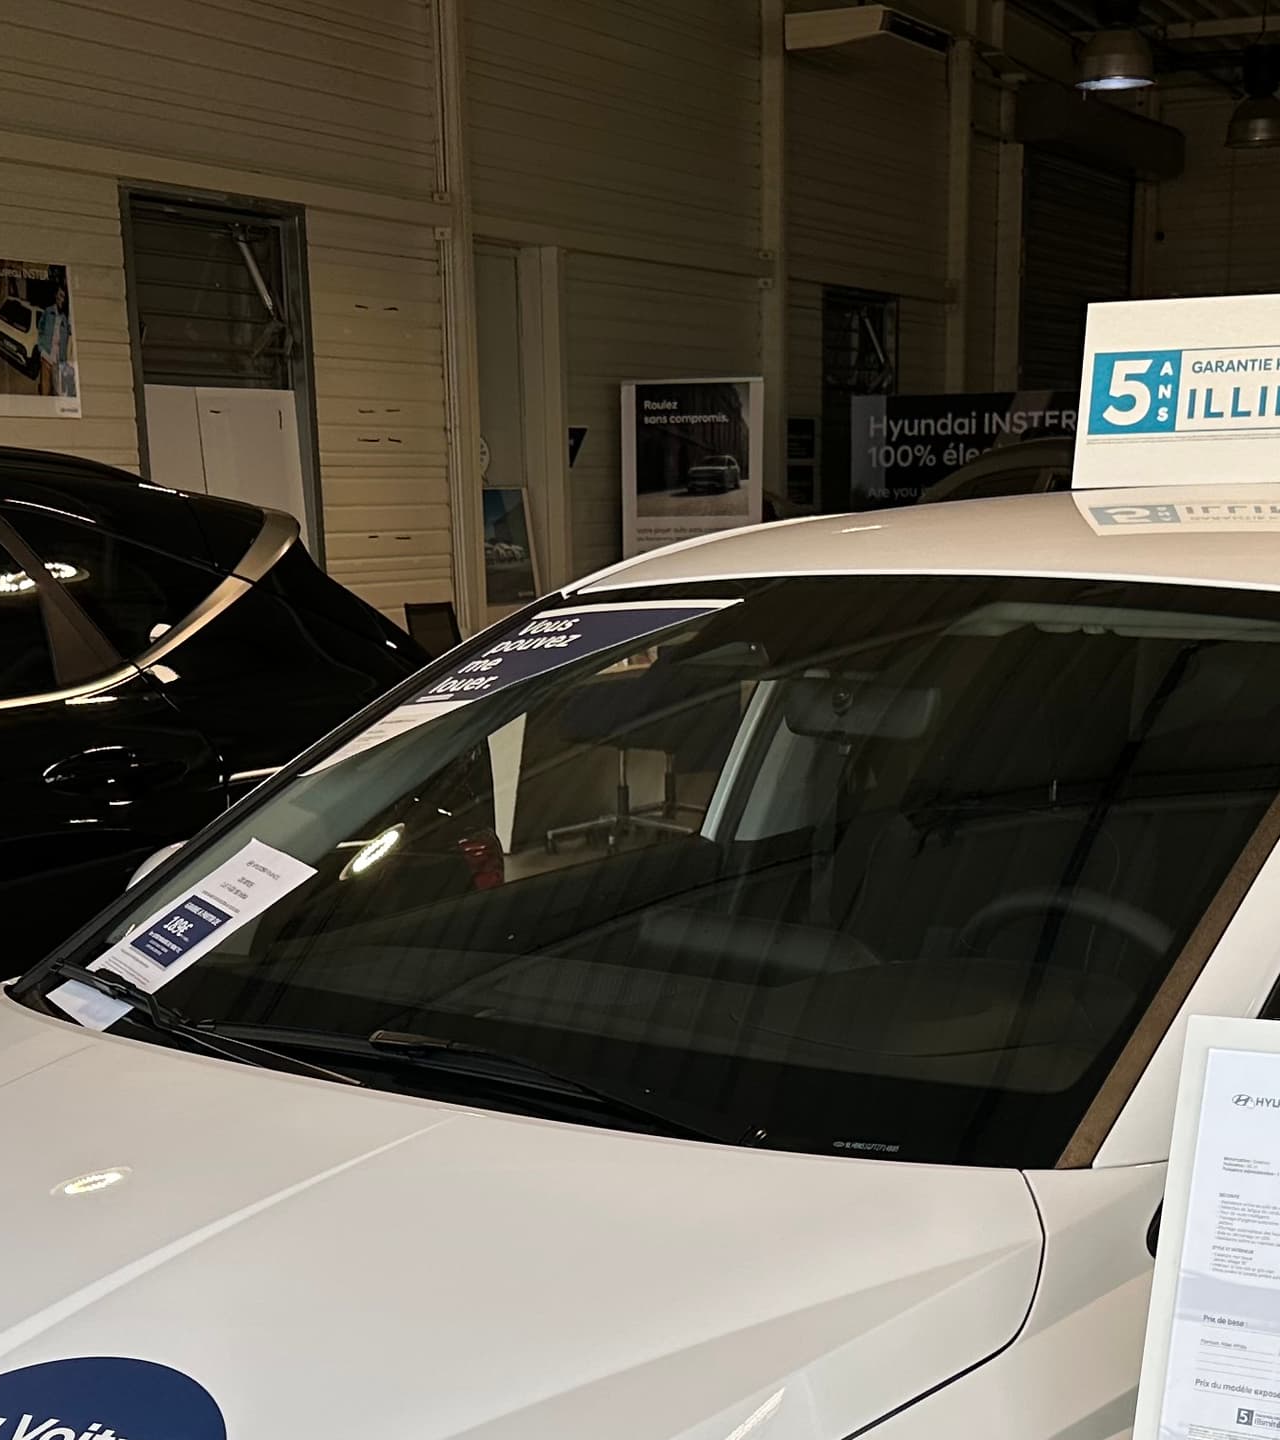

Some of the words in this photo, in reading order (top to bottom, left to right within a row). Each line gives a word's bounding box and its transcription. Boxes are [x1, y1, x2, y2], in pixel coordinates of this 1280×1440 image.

[1191, 358, 1272, 374] GARANTIE
[1102, 359, 1153, 425] 5
[644, 400, 679, 410] Roulez
[644, 416, 667, 424] sans
[670, 413, 729, 424] compromis.
[870, 412, 976, 441] Hyundai
[869, 445, 936, 468] 100%
[518, 618, 580, 636] Vous
[481, 634, 582, 658] pouvez
[458, 657, 503, 674] me
[429, 676, 499, 694] louer.
[1203, 1314, 1215, 1323] Prix
[1217, 1317, 1226, 1325] de
[1227, 1319, 1244, 1327] base
[1195, 1379, 1209, 1388] Prix
[1223, 1383, 1253, 1394] modèle
[1239, 1410, 1248, 1423] 5
